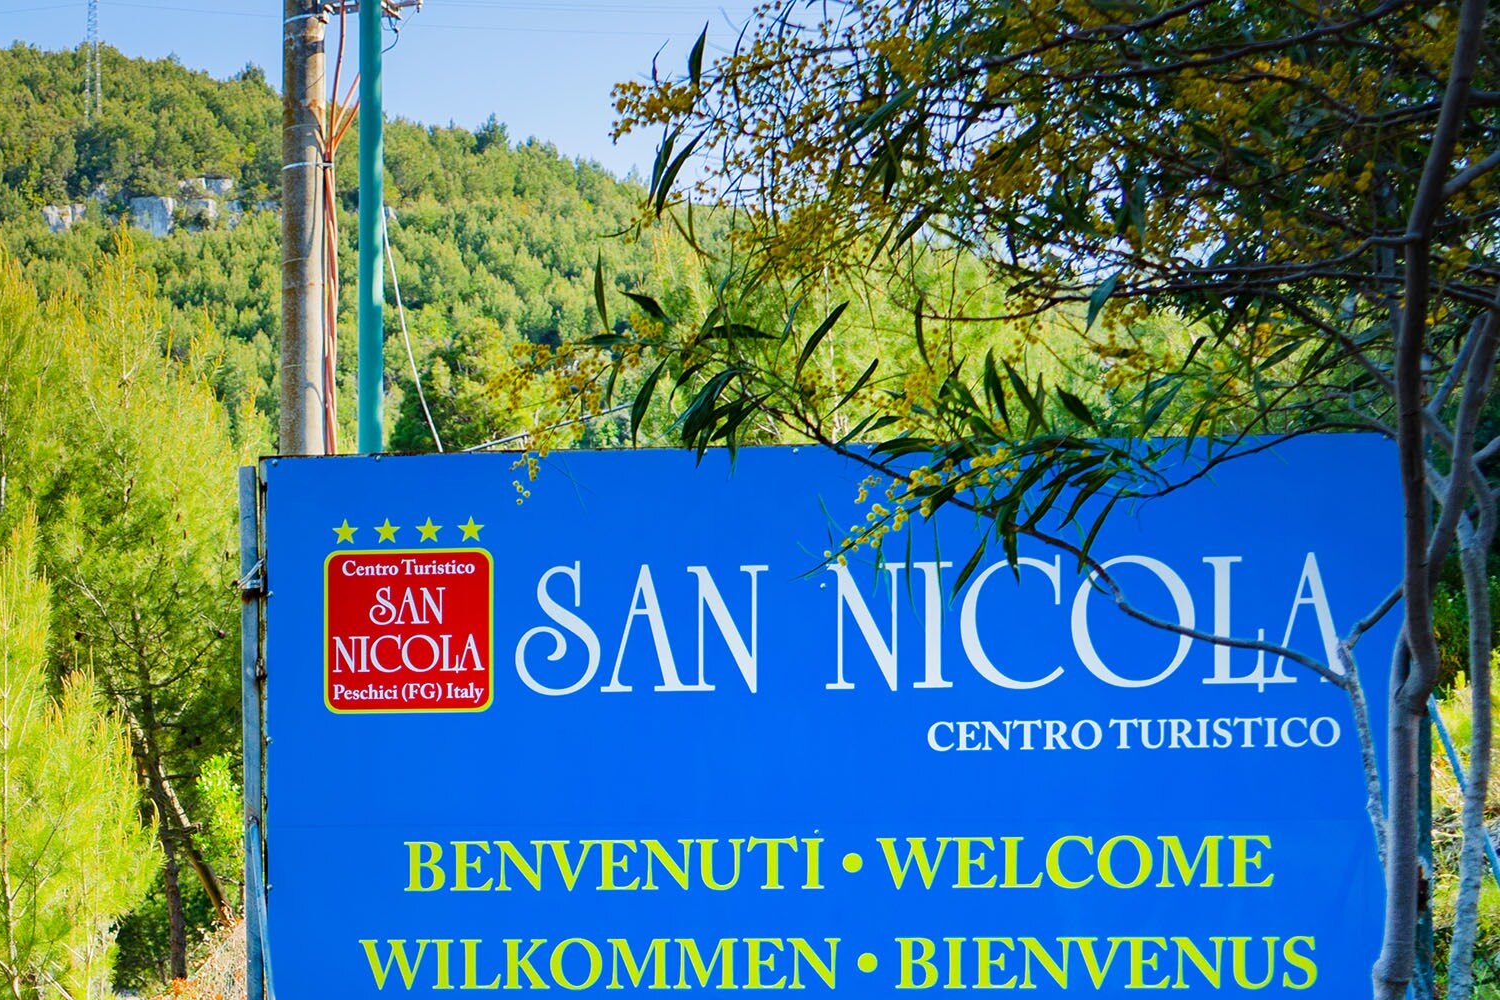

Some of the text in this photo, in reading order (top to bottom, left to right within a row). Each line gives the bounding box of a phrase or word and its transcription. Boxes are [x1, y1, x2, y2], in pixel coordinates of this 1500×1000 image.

[342, 558, 476, 576] Centro Turistico
[369, 586, 446, 625] SAN
[515, 552, 1347, 696] SAN NICOLA
[332, 633, 485, 674] NICOLA
[332, 682, 485, 704] Peschici (FG) Italy
[927, 717, 1341, 752] CENTRO TURISTICO
[403, 835, 1275, 892] BENVENUTI WELCOME
[358, 935, 1318, 990] WILKOMMEN BIENVENUS
